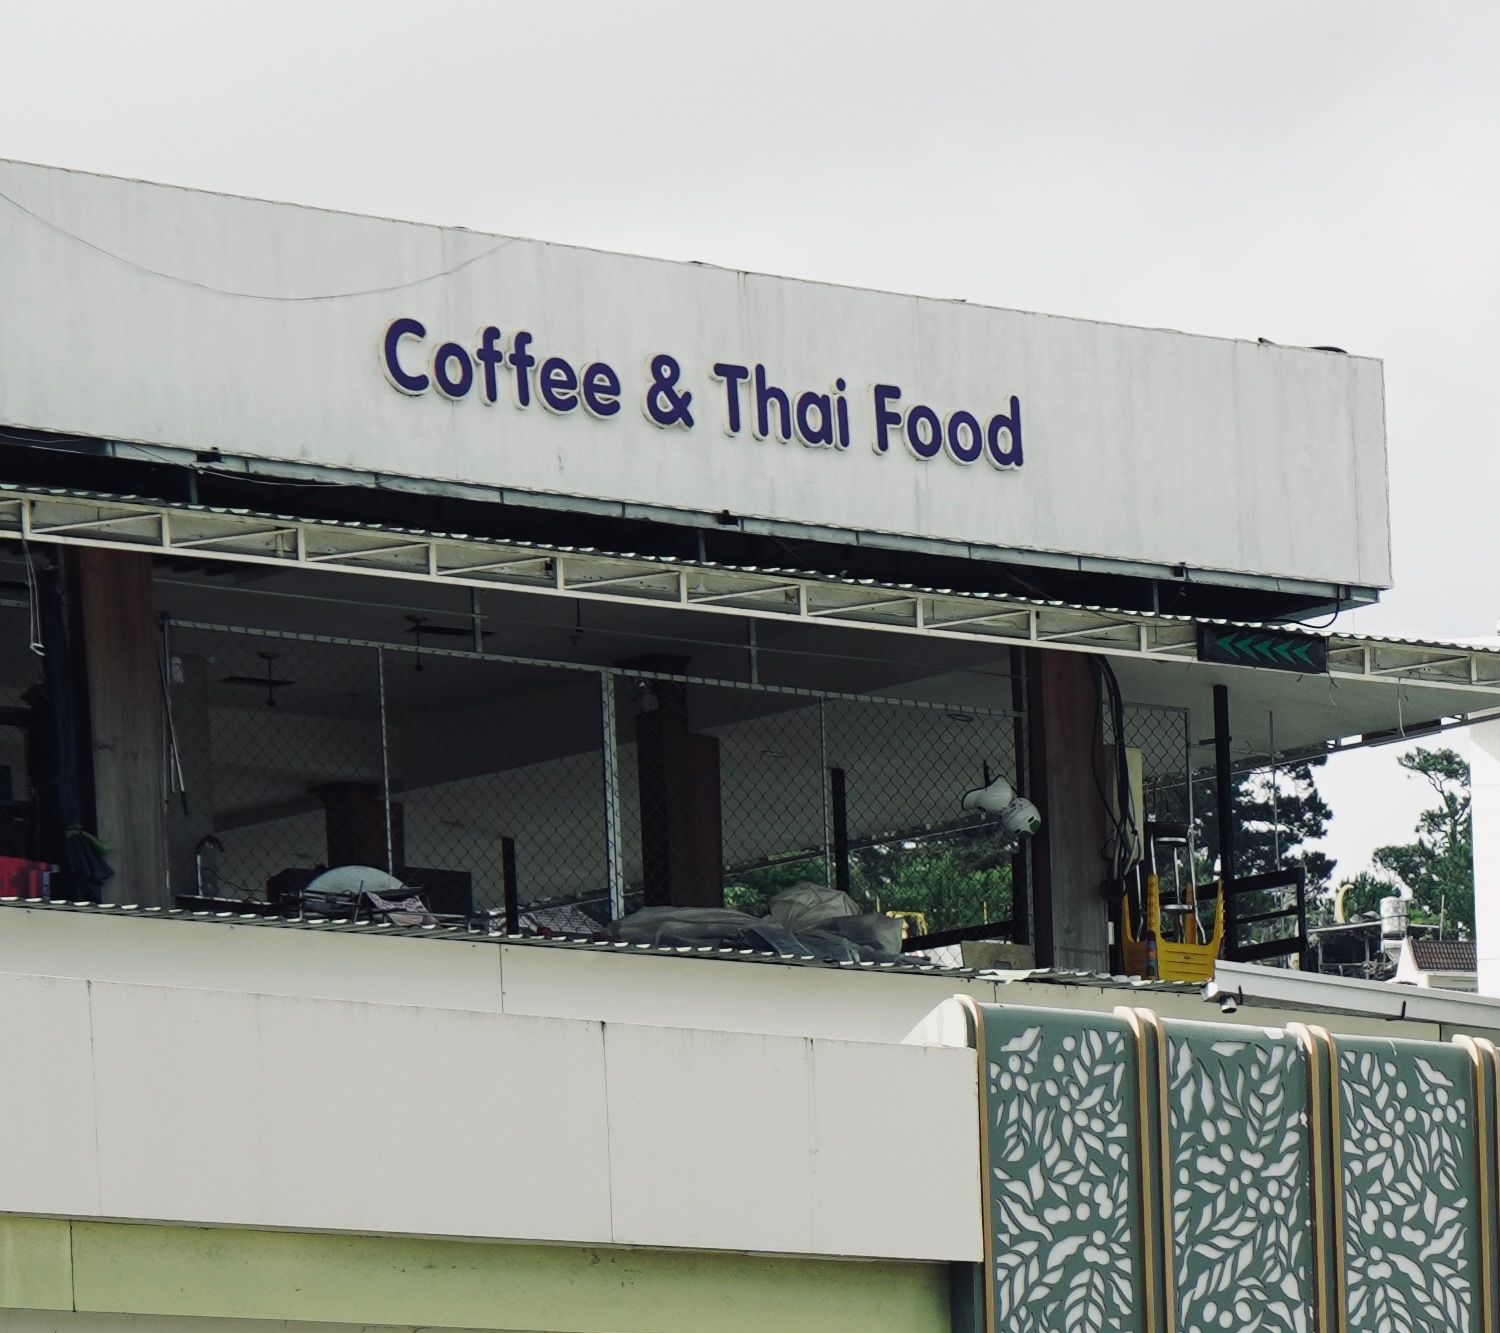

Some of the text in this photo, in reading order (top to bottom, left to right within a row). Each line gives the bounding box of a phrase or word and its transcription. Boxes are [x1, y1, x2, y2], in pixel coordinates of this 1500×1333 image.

[380, 317, 1025, 471] Coffee & Thai Food
